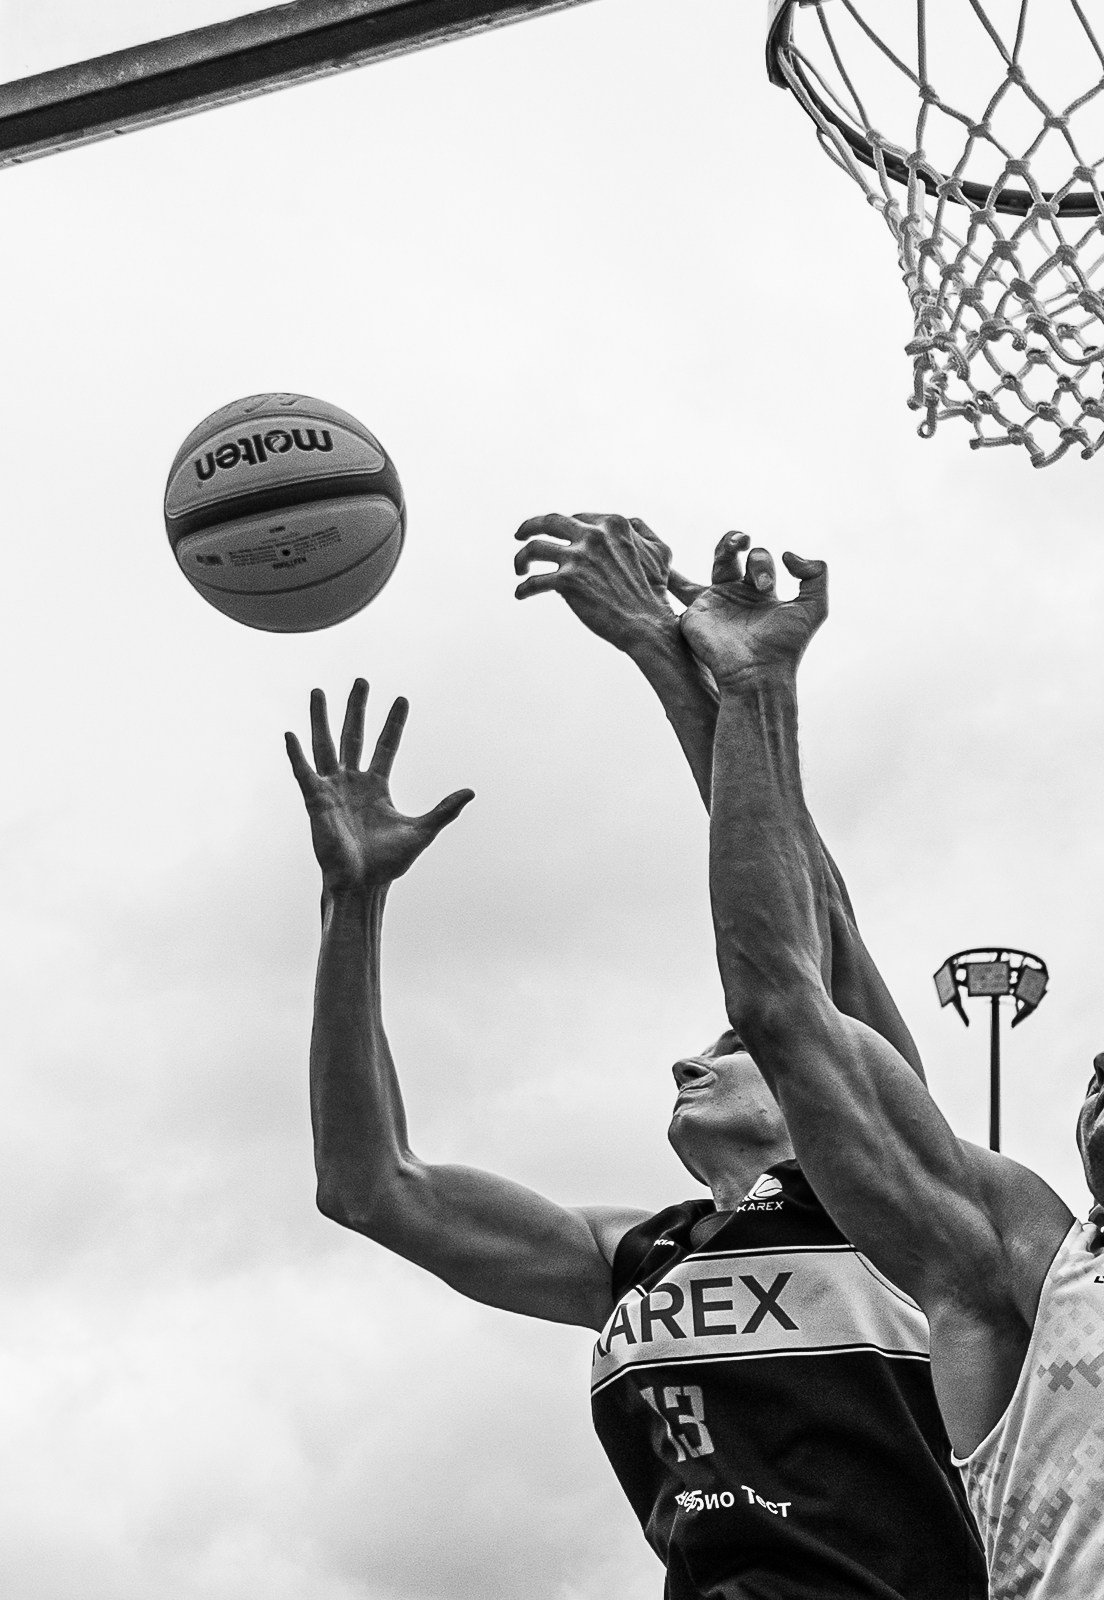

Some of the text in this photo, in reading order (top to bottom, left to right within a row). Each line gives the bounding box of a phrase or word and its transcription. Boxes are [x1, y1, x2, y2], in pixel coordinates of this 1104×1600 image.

[193, 429, 334, 481] molten
[736, 1201, 784, 1213] KAREX
[640, 1385, 715, 1463] 13
[741, 1485, 792, 1518] Тест
